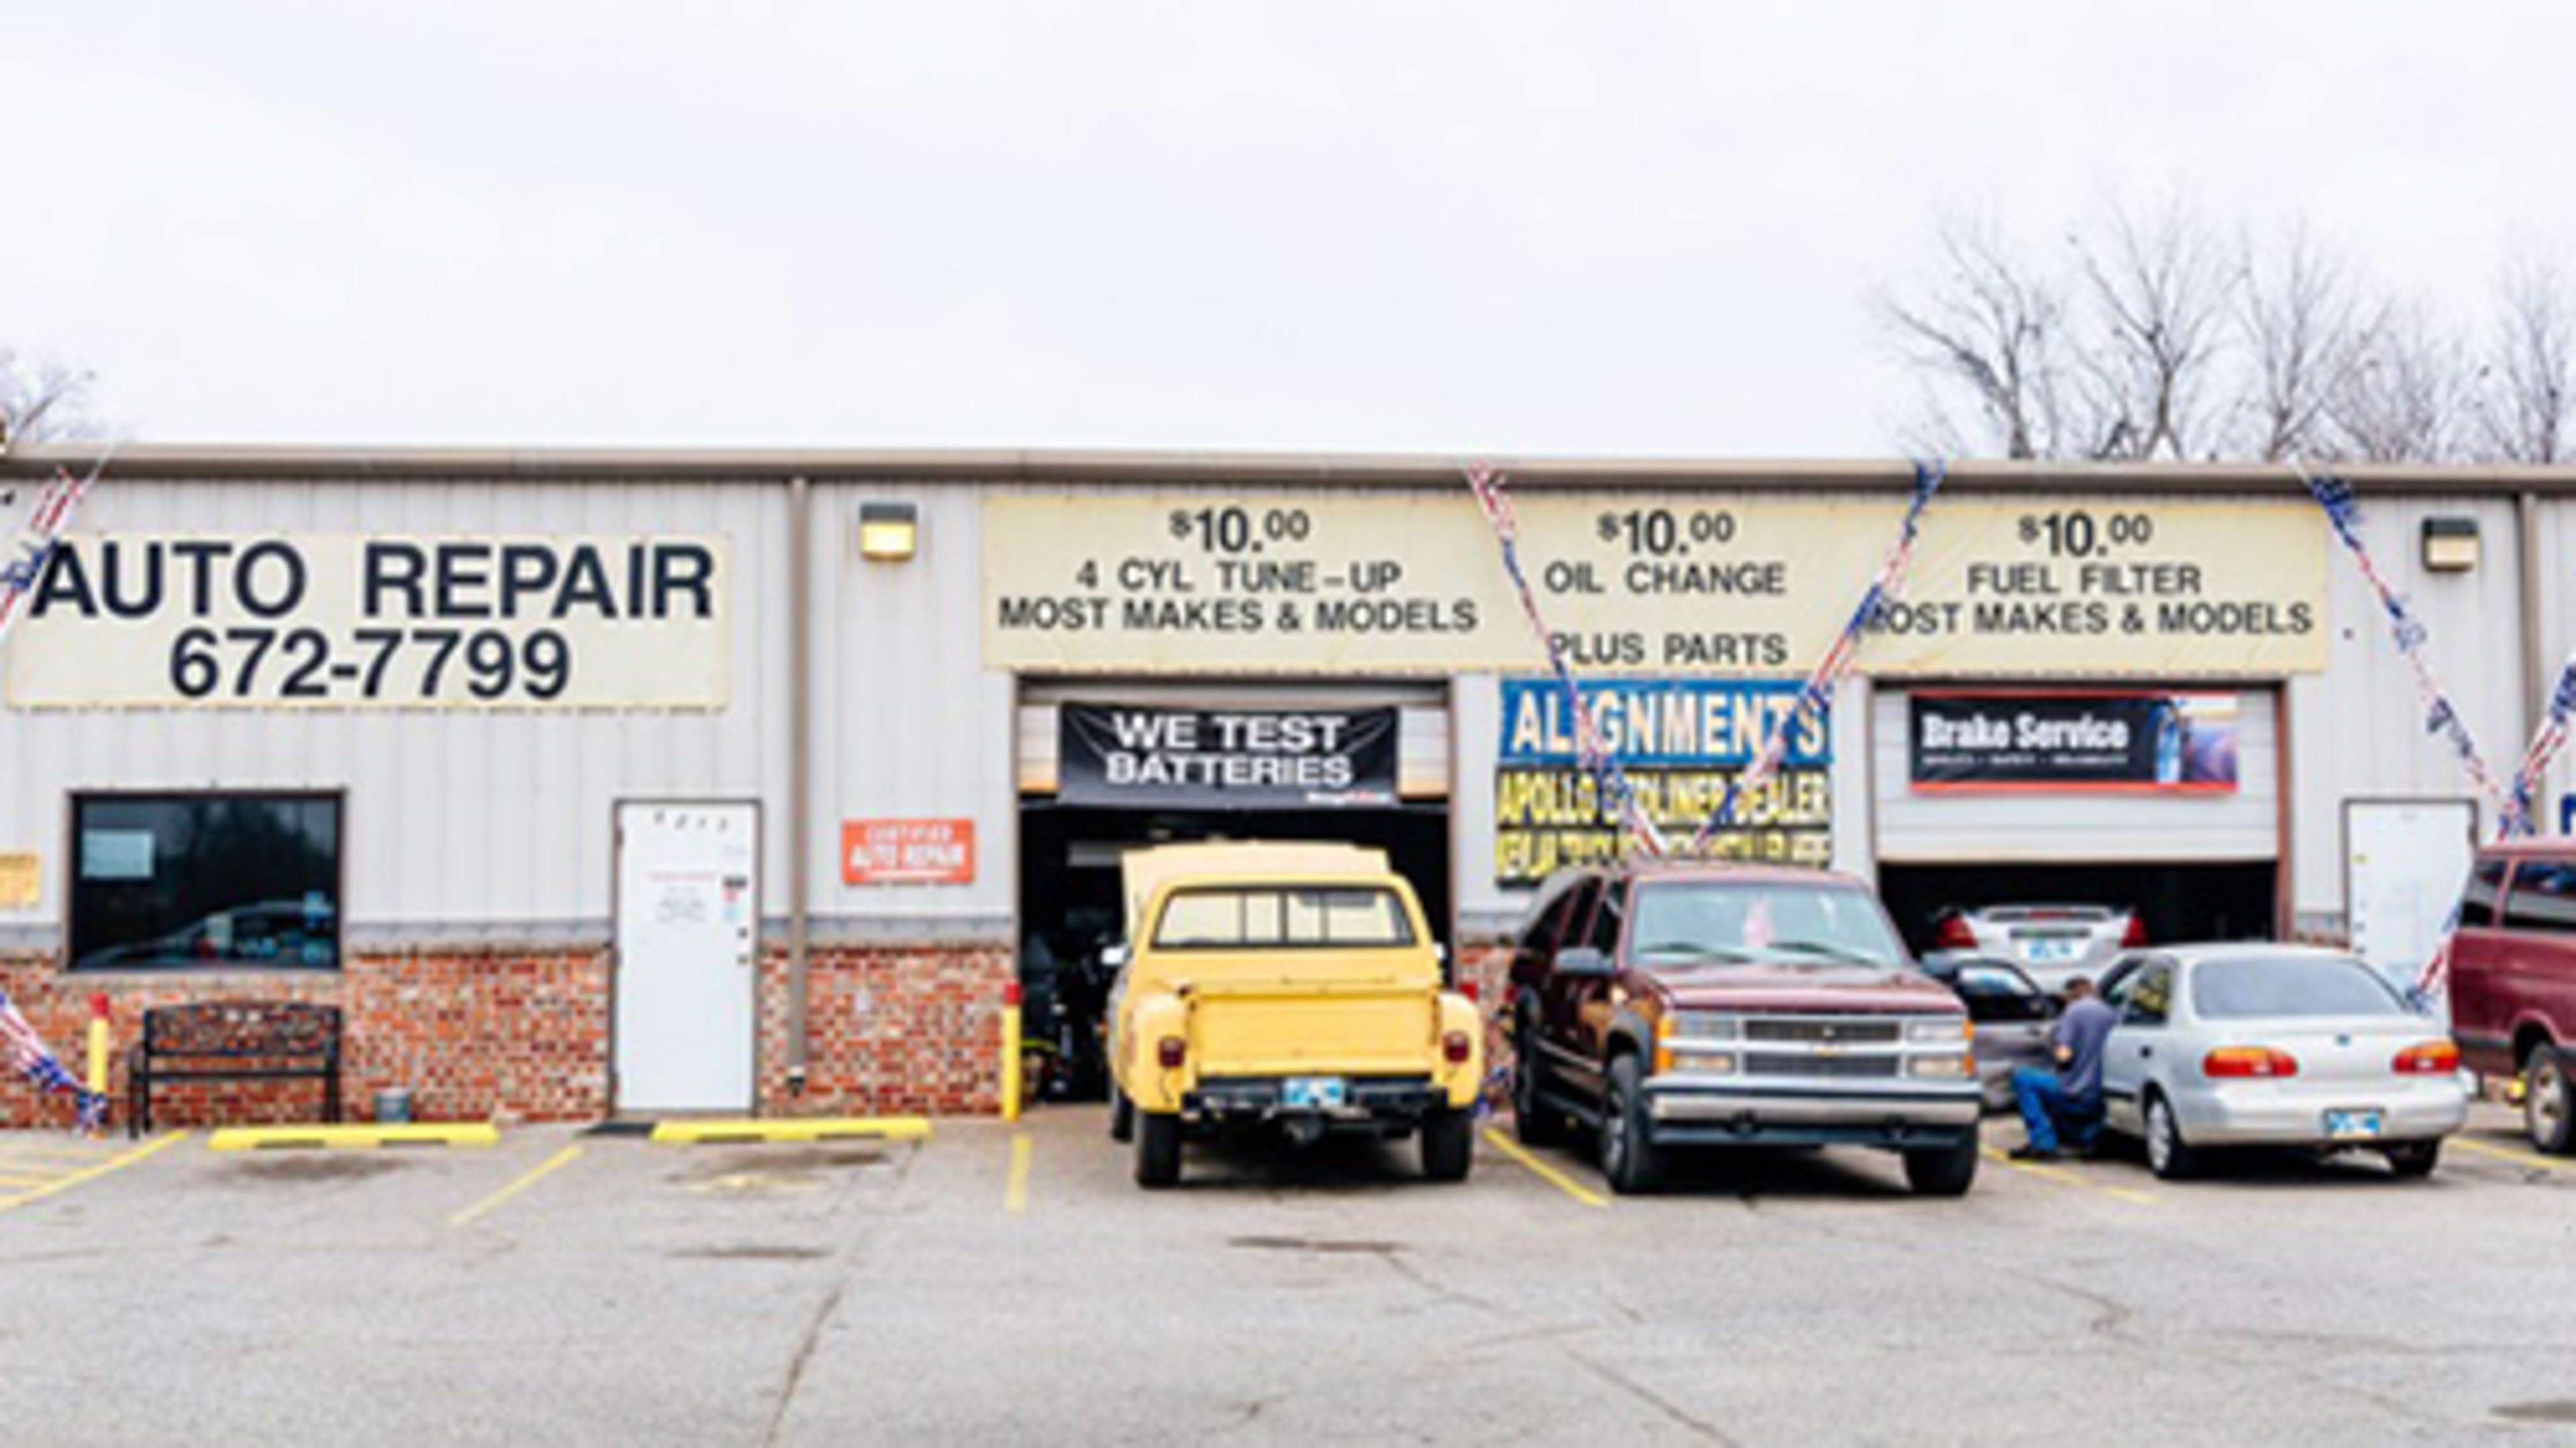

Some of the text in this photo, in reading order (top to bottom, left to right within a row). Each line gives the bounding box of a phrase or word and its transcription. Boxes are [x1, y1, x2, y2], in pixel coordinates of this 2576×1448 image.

[30, 539, 714, 619] AUTO REPAIR
[1077, 558, 1402, 593] 4 CYL TUNE-UP
[1544, 561, 1786, 594] OIL CHANGE
[1968, 564, 2202, 594] FUEL FILTER
[999, 597, 1479, 632] MOST MAKES & MODELS
[1974, 602, 2109, 634] MAKES
[2121, 604, 2145, 633] &
[2157, 603, 2314, 635] MODELS
[170, 628, 570, 700] 672-7799
[1550, 633, 1788, 665] PLUS PARTS
[1112, 714, 1347, 752] WE TEST
[1921, 713, 2129, 749] Brake Service
[1106, 752, 1352, 788] BATTERIES
